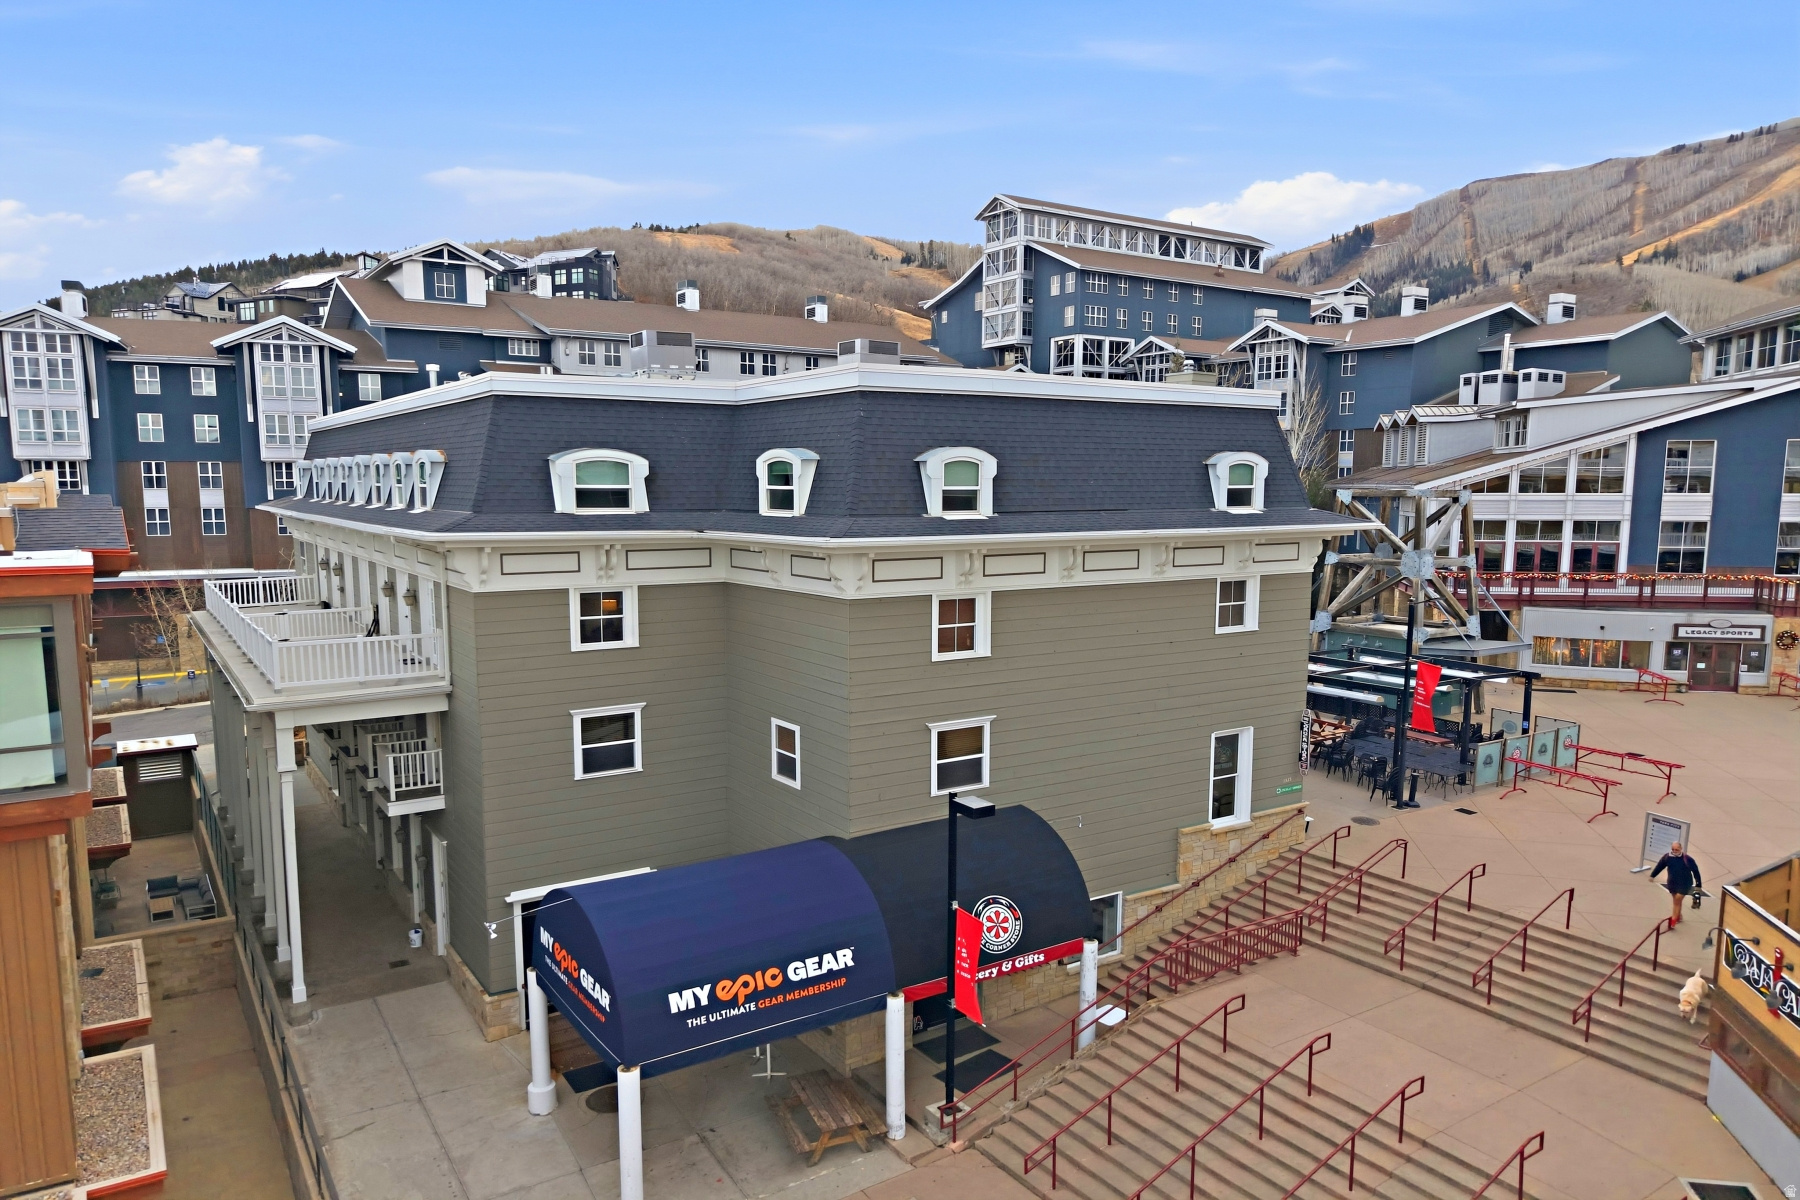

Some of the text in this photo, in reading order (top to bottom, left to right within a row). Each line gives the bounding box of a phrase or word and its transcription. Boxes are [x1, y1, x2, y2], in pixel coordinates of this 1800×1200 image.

[540, 925, 554, 953] MY
[985, 941, 1012, 951] CORNER
[1010, 920, 1021, 943] STORE
[1002, 960, 1013, 972] &
[1014, 953, 1045, 968] Gifts
[668, 983, 712, 1014] MY
[686, 977, 847, 1028] THE ULTIMATE GEAR MEMBERSHIP
[1775, 981, 1800, 1018] CA
